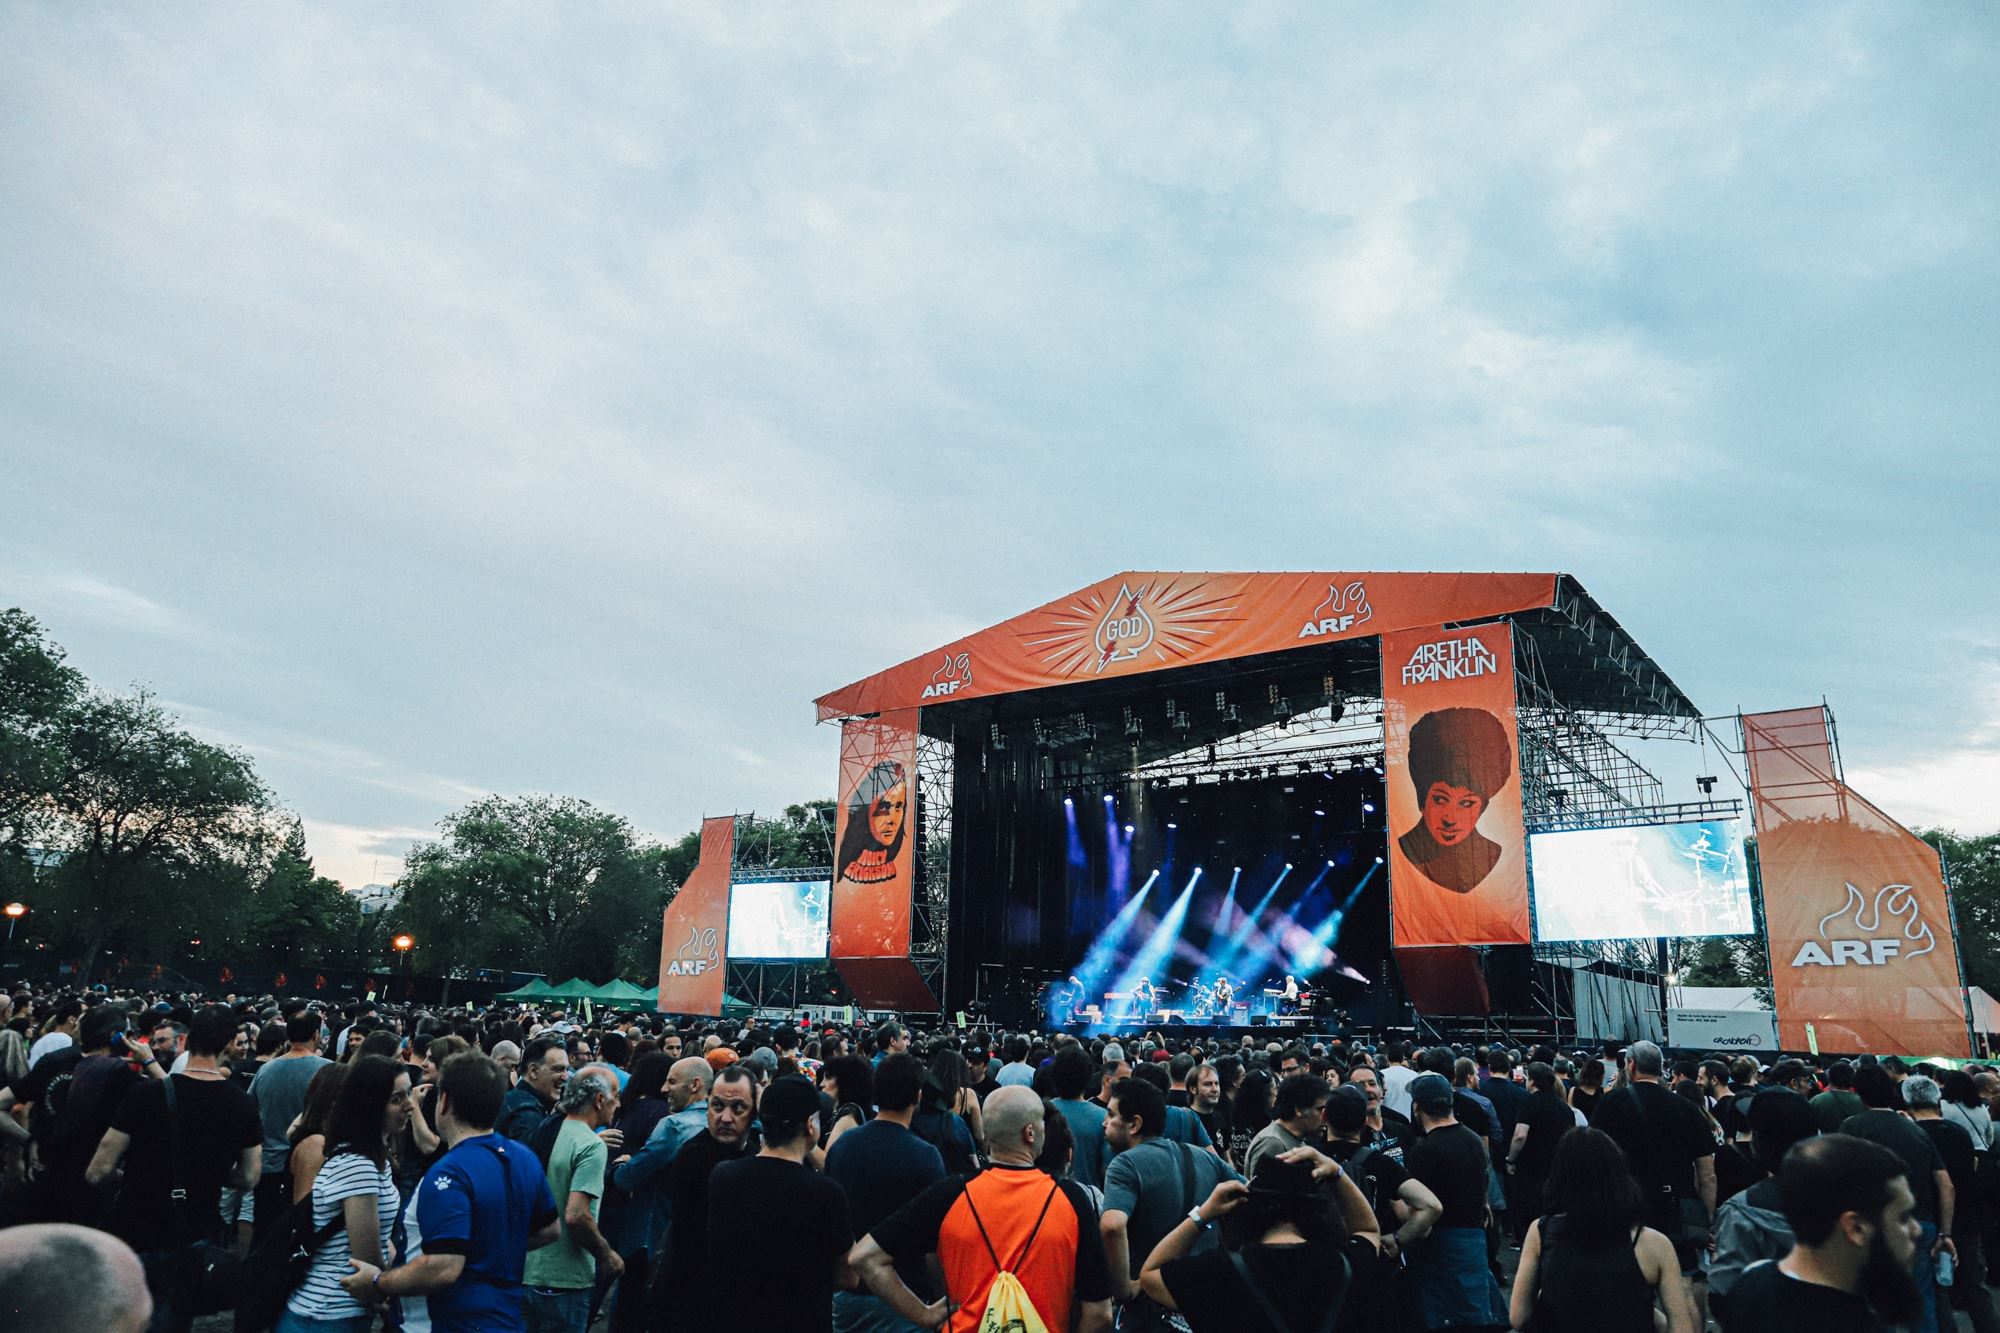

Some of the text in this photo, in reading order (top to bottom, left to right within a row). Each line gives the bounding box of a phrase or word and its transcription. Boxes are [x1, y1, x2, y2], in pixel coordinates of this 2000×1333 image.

[1107, 616, 1142, 640] GOD
[1298, 614, 1355, 638] ARF
[1408, 637, 1490, 666] ARETHA
[1402, 653, 1497, 686] FRANKLIN
[921, 680, 960, 699] ARF
[1791, 939, 1900, 967] ARF
[667, 960, 707, 976] ARF
